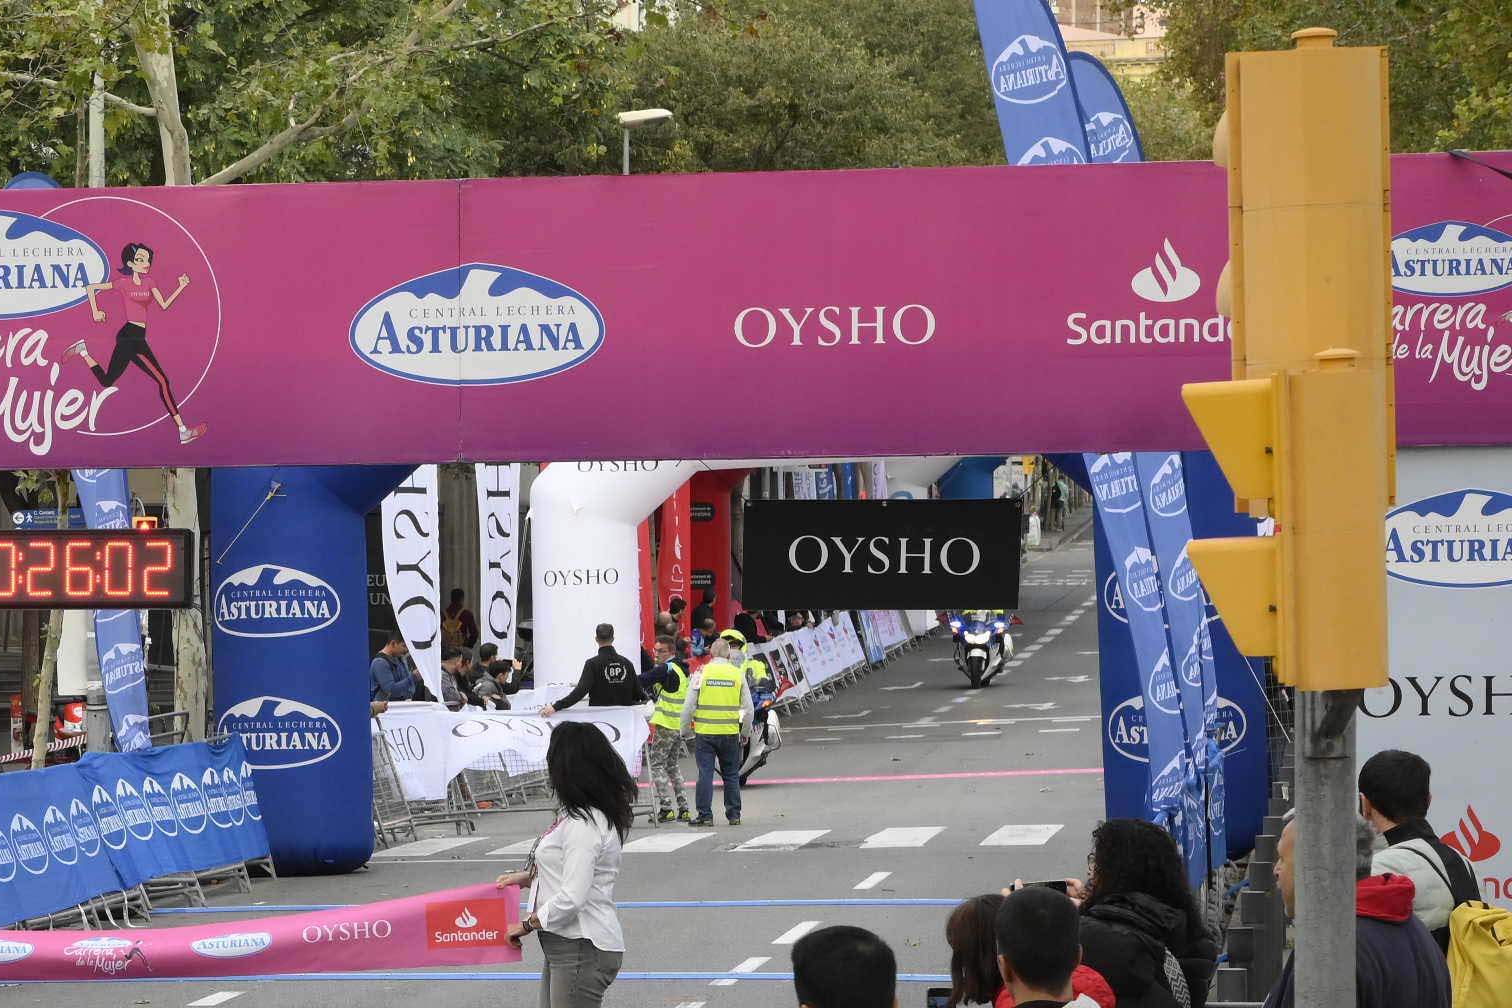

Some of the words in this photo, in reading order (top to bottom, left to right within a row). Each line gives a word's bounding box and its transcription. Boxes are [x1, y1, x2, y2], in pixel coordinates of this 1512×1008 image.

[11, 247, 85, 258] LECHERA
[409, 307, 488, 319] CENTRAL
[495, 305, 577, 316] LECHERA
[1392, 302, 1487, 331] arrera
[369, 311, 585, 355] ASTURIANA
[734, 304, 937, 347] OYSHO
[1415, 332, 1433, 359] la
[1428, 326, 1512, 391] Muje
[1412, 524, 1481, 534] CENTRAL
[788, 535, 981, 576] OYSHO
[1385, 527, 1512, 564] ASTURIA
[544, 567, 619, 588] OYSHO
[231, 589, 273, 598] CENTRAL
[278, 588, 326, 597] LECHERA
[218, 594, 332, 622] ASTURIANA
[1360, 674, 1512, 719] OYSH
[232, 721, 274, 729] CENTRAL
[278, 720, 327, 729] LECHERA
[222, 724, 332, 751] TURIANA
[195, 936, 266, 949] ASTURIANA
[302, 920, 392, 944] OYSHO
[435, 928, 499, 943] Santander
[94, 950, 133, 975] Mujer
